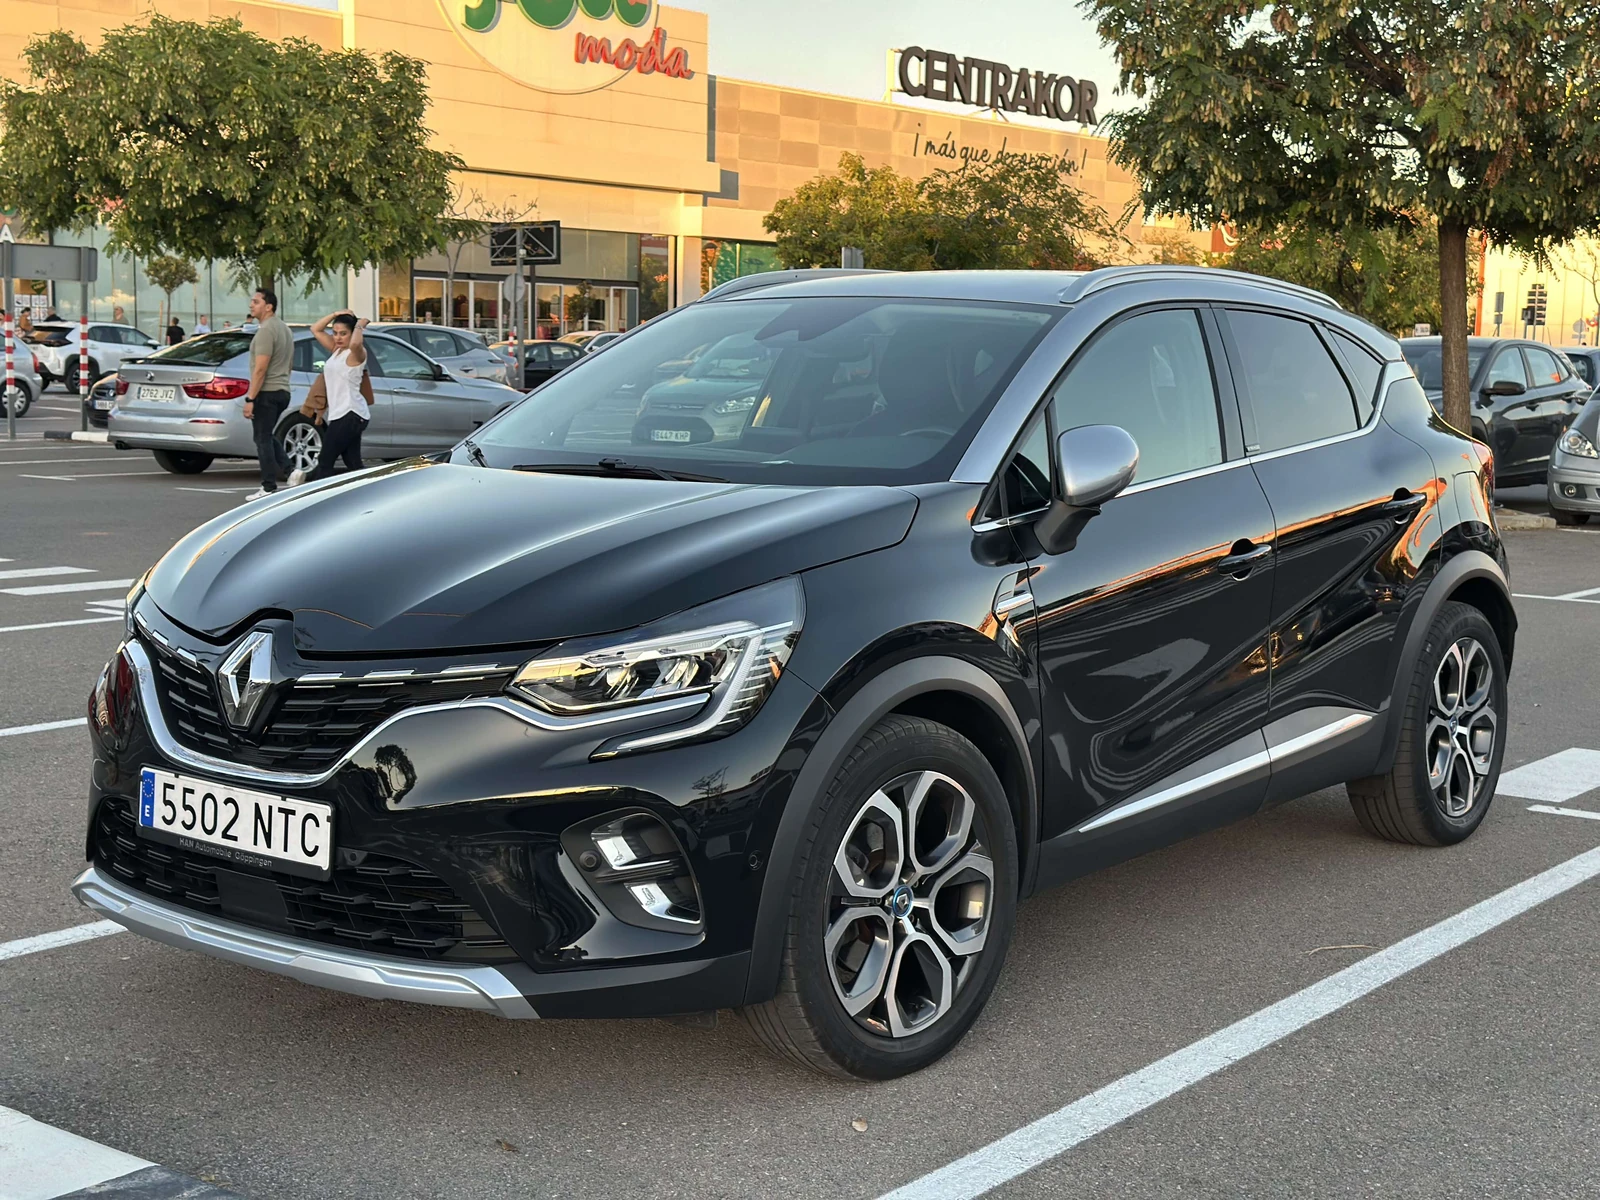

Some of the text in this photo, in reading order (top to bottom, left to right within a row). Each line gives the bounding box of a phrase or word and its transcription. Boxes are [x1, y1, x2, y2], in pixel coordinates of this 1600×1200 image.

[574, 27, 693, 79] moda
[899, 46, 1098, 125] CENTRAKOR
[960, 145, 991, 172] que
[144, 782, 320, 858] E 5502 NTC
[179, 837, 273, 867] HAN Automobile Göppingen
